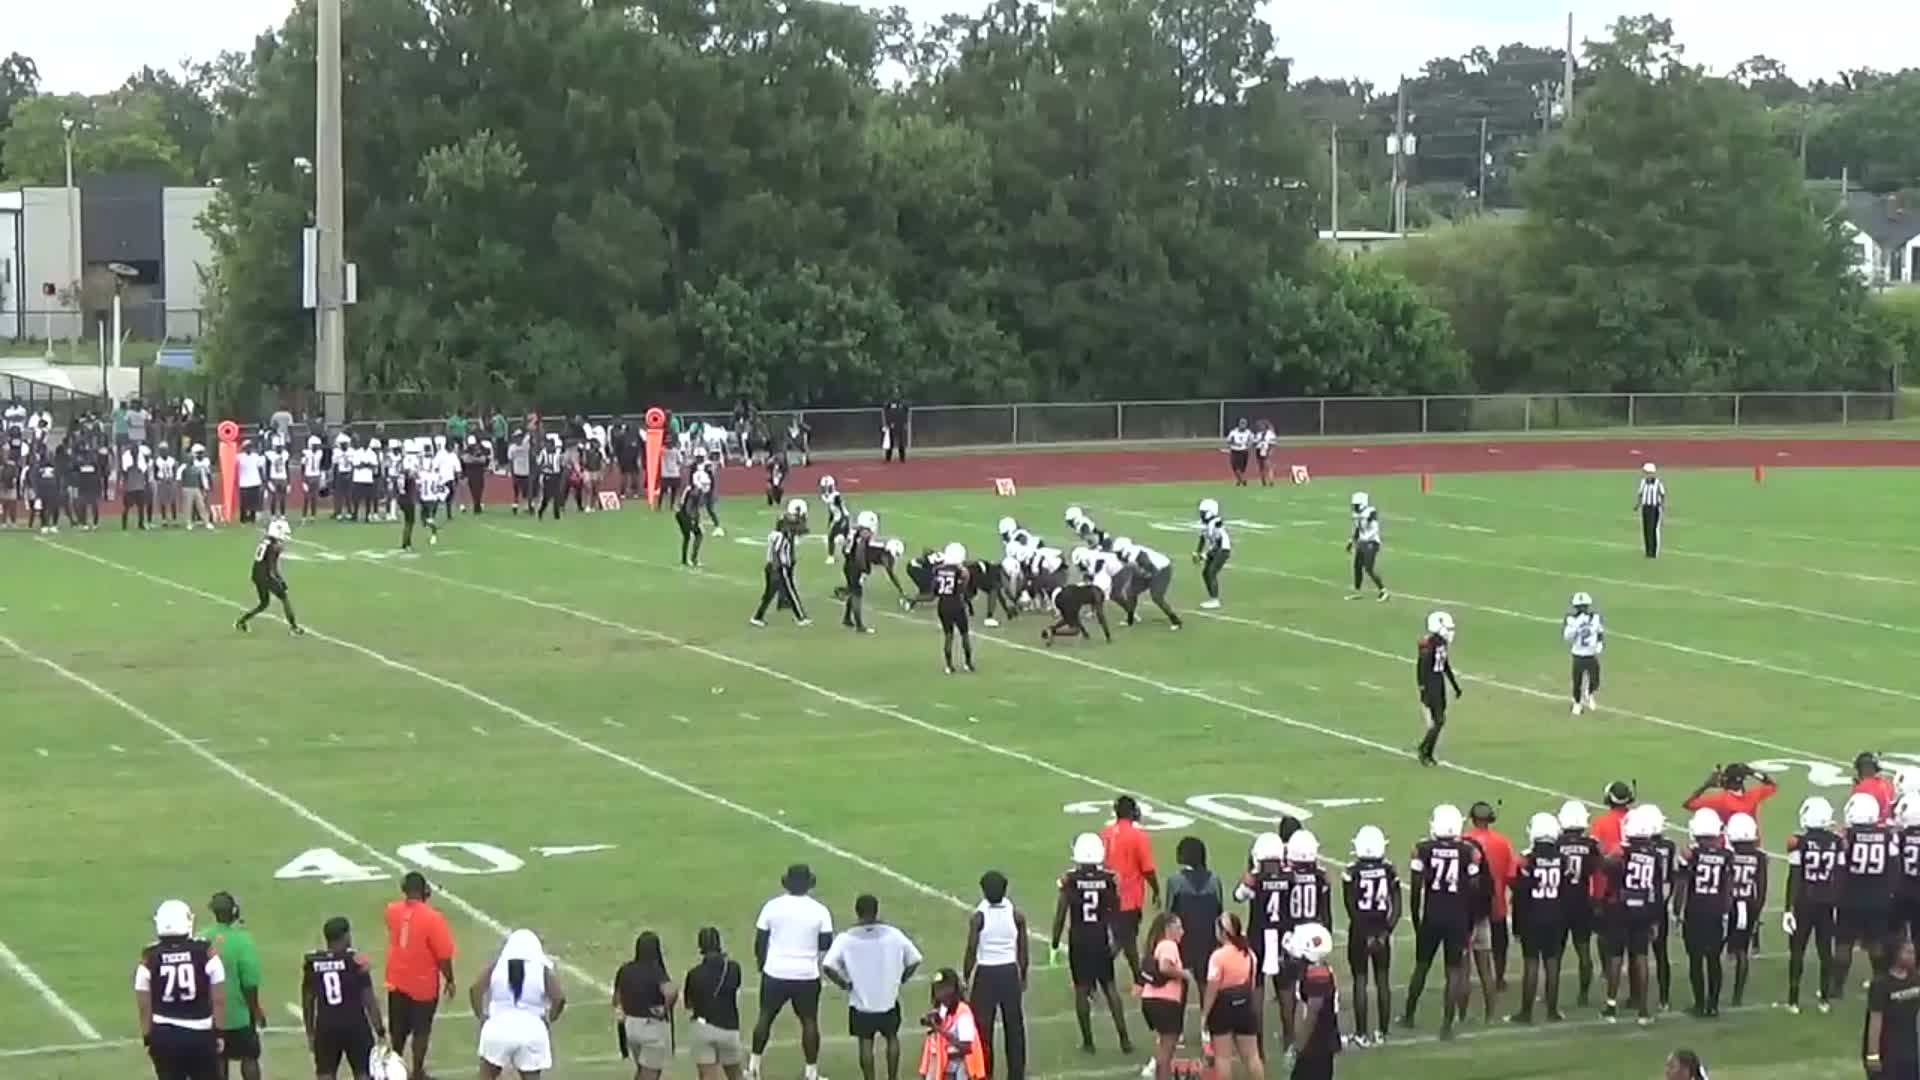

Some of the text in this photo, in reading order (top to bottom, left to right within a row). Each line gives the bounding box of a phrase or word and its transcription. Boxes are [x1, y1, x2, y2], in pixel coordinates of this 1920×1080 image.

[1064, 794, 1313, 830] 30
[273, 842, 525, 884] 40
[1804, 850, 1836, 881] 23
[1850, 842, 1884, 874] 99
[1431, 859, 1459, 892] 74
[1695, 864, 1720, 893] 21
[1082, 890, 1099, 922] 2
[1266, 891, 1280, 922] 4
[1290, 884, 1317, 919] 80
[1358, 878, 1388, 911] 34
[160, 963, 196, 1002] 79
[323, 971, 342, 1005] 8
